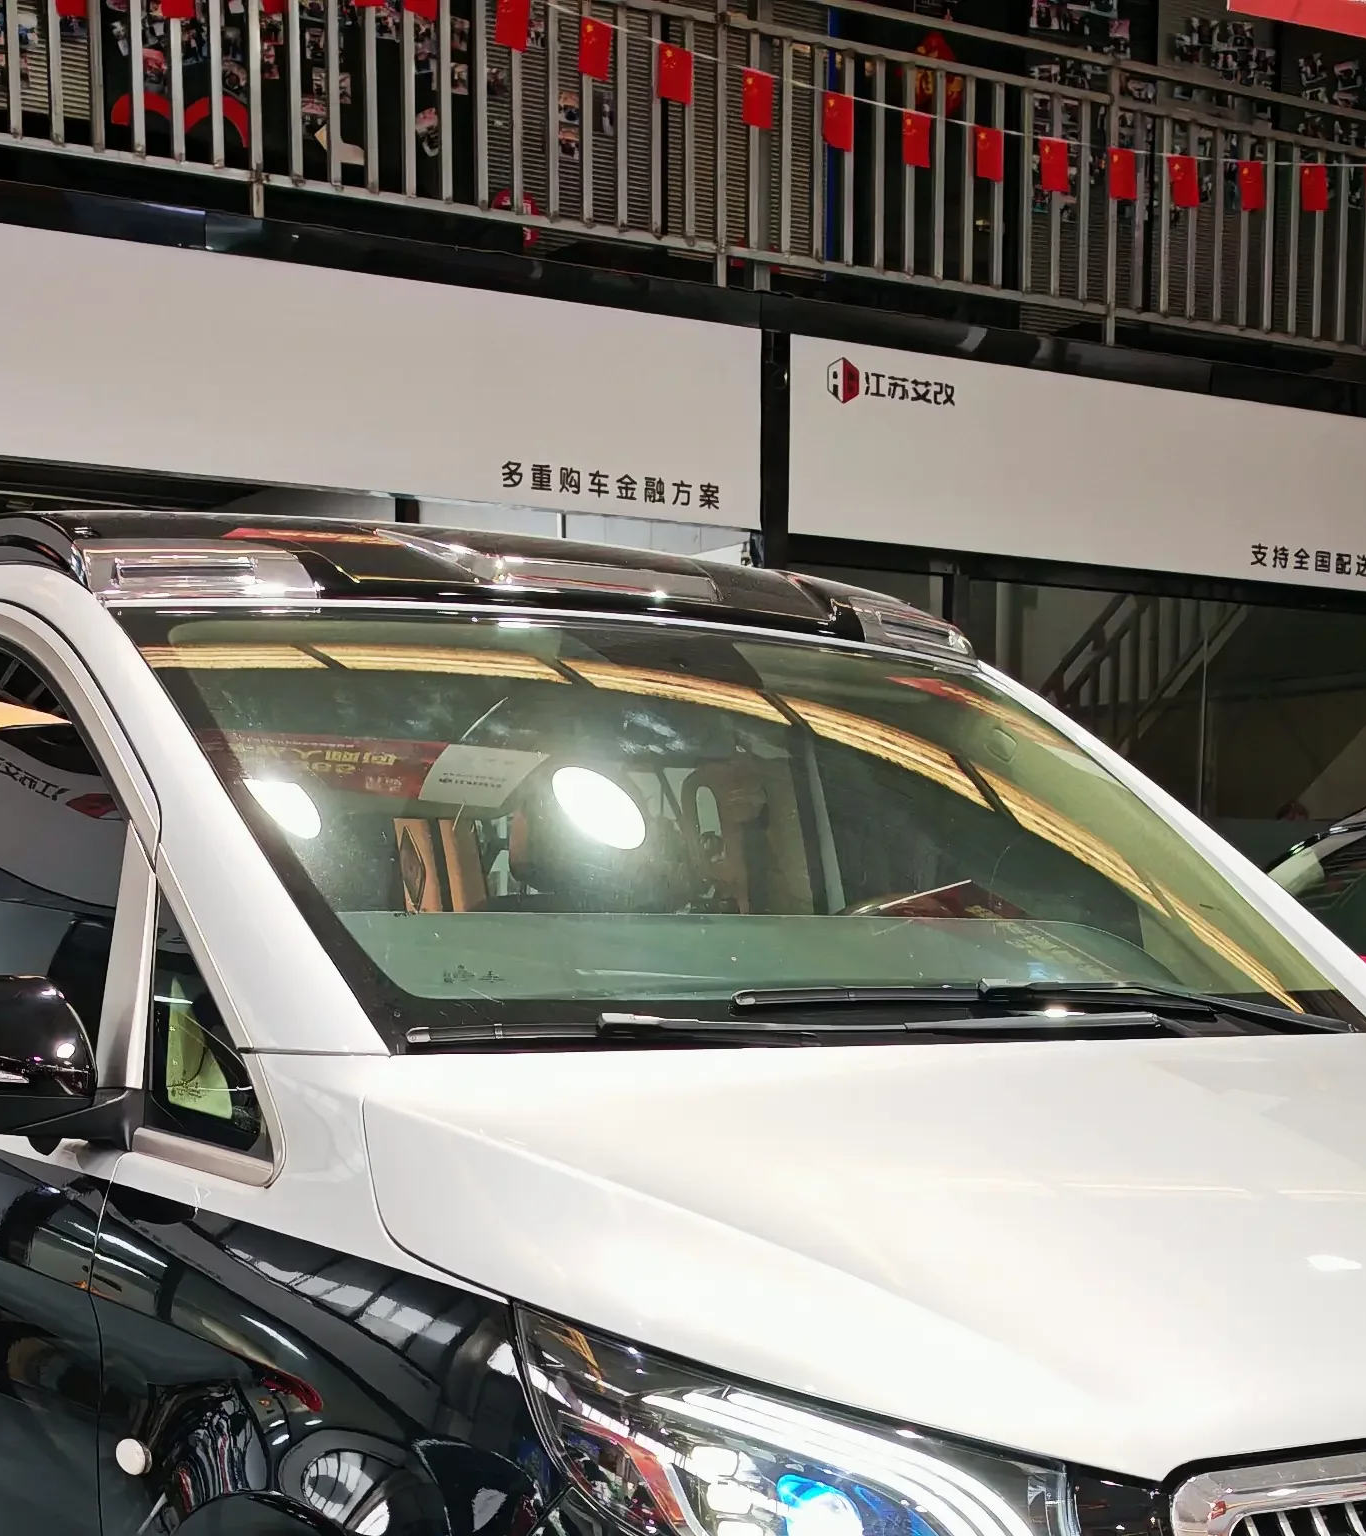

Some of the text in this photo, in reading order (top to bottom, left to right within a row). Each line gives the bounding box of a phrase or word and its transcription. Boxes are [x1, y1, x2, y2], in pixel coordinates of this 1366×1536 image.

[864, 371, 955, 406] 江苏艾改
[501, 460, 720, 510] 多重购车金融方案
